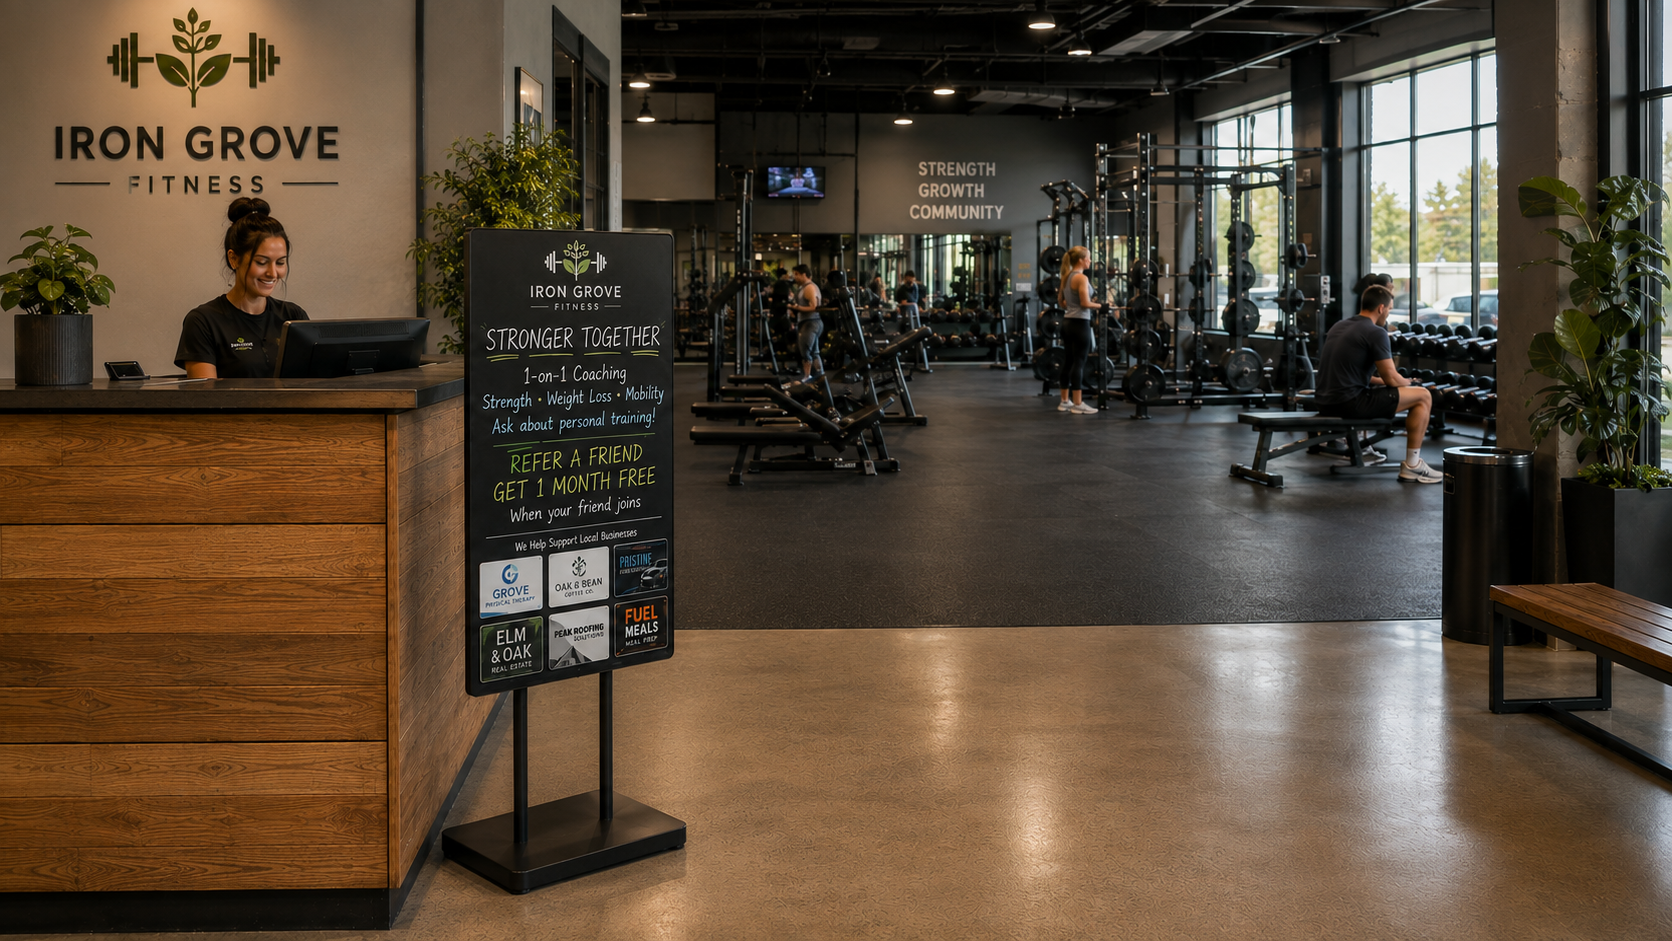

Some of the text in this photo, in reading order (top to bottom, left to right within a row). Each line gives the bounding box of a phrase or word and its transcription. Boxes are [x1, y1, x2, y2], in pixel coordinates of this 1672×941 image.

[55, 125, 340, 161] IRON GROVE
[918, 161, 996, 177] STRENGTH
[129, 175, 264, 195] FITNESS
[918, 182, 985, 198] GROWTH
[909, 204, 1004, 220] COMMUNITY
[530, 285, 622, 298] IRON GROVE
[554, 303, 599, 311] FITNESS
[486, 325, 660, 351] STRONGER TOGETHER
[523, 364, 627, 385] 1-on-1 Coaching
[482, 384, 664, 413] Strength Weight Loss Mobility
[492, 407, 656, 435] Ask about personal training!
[510, 443, 643, 474] REFER A FRIEND
[493, 466, 656, 503] GET 1 MONTH FREE
[510, 496, 641, 524] When your friend joins
[514, 542, 528, 552] We
[529, 539, 547, 551] Help
[548, 535, 578, 549] Support
[579, 532, 599, 543] Local
[492, 585, 529, 599] GROVE
[554, 582, 572, 592] OAK
[581, 577, 603, 588] BEAN
[625, 604, 658, 625] FUEL
[496, 626, 526, 646] ELM
[554, 623, 604, 638] PEAK ROOFING
[625, 621, 659, 638] MEALS
[491, 643, 532, 663] & OAK
